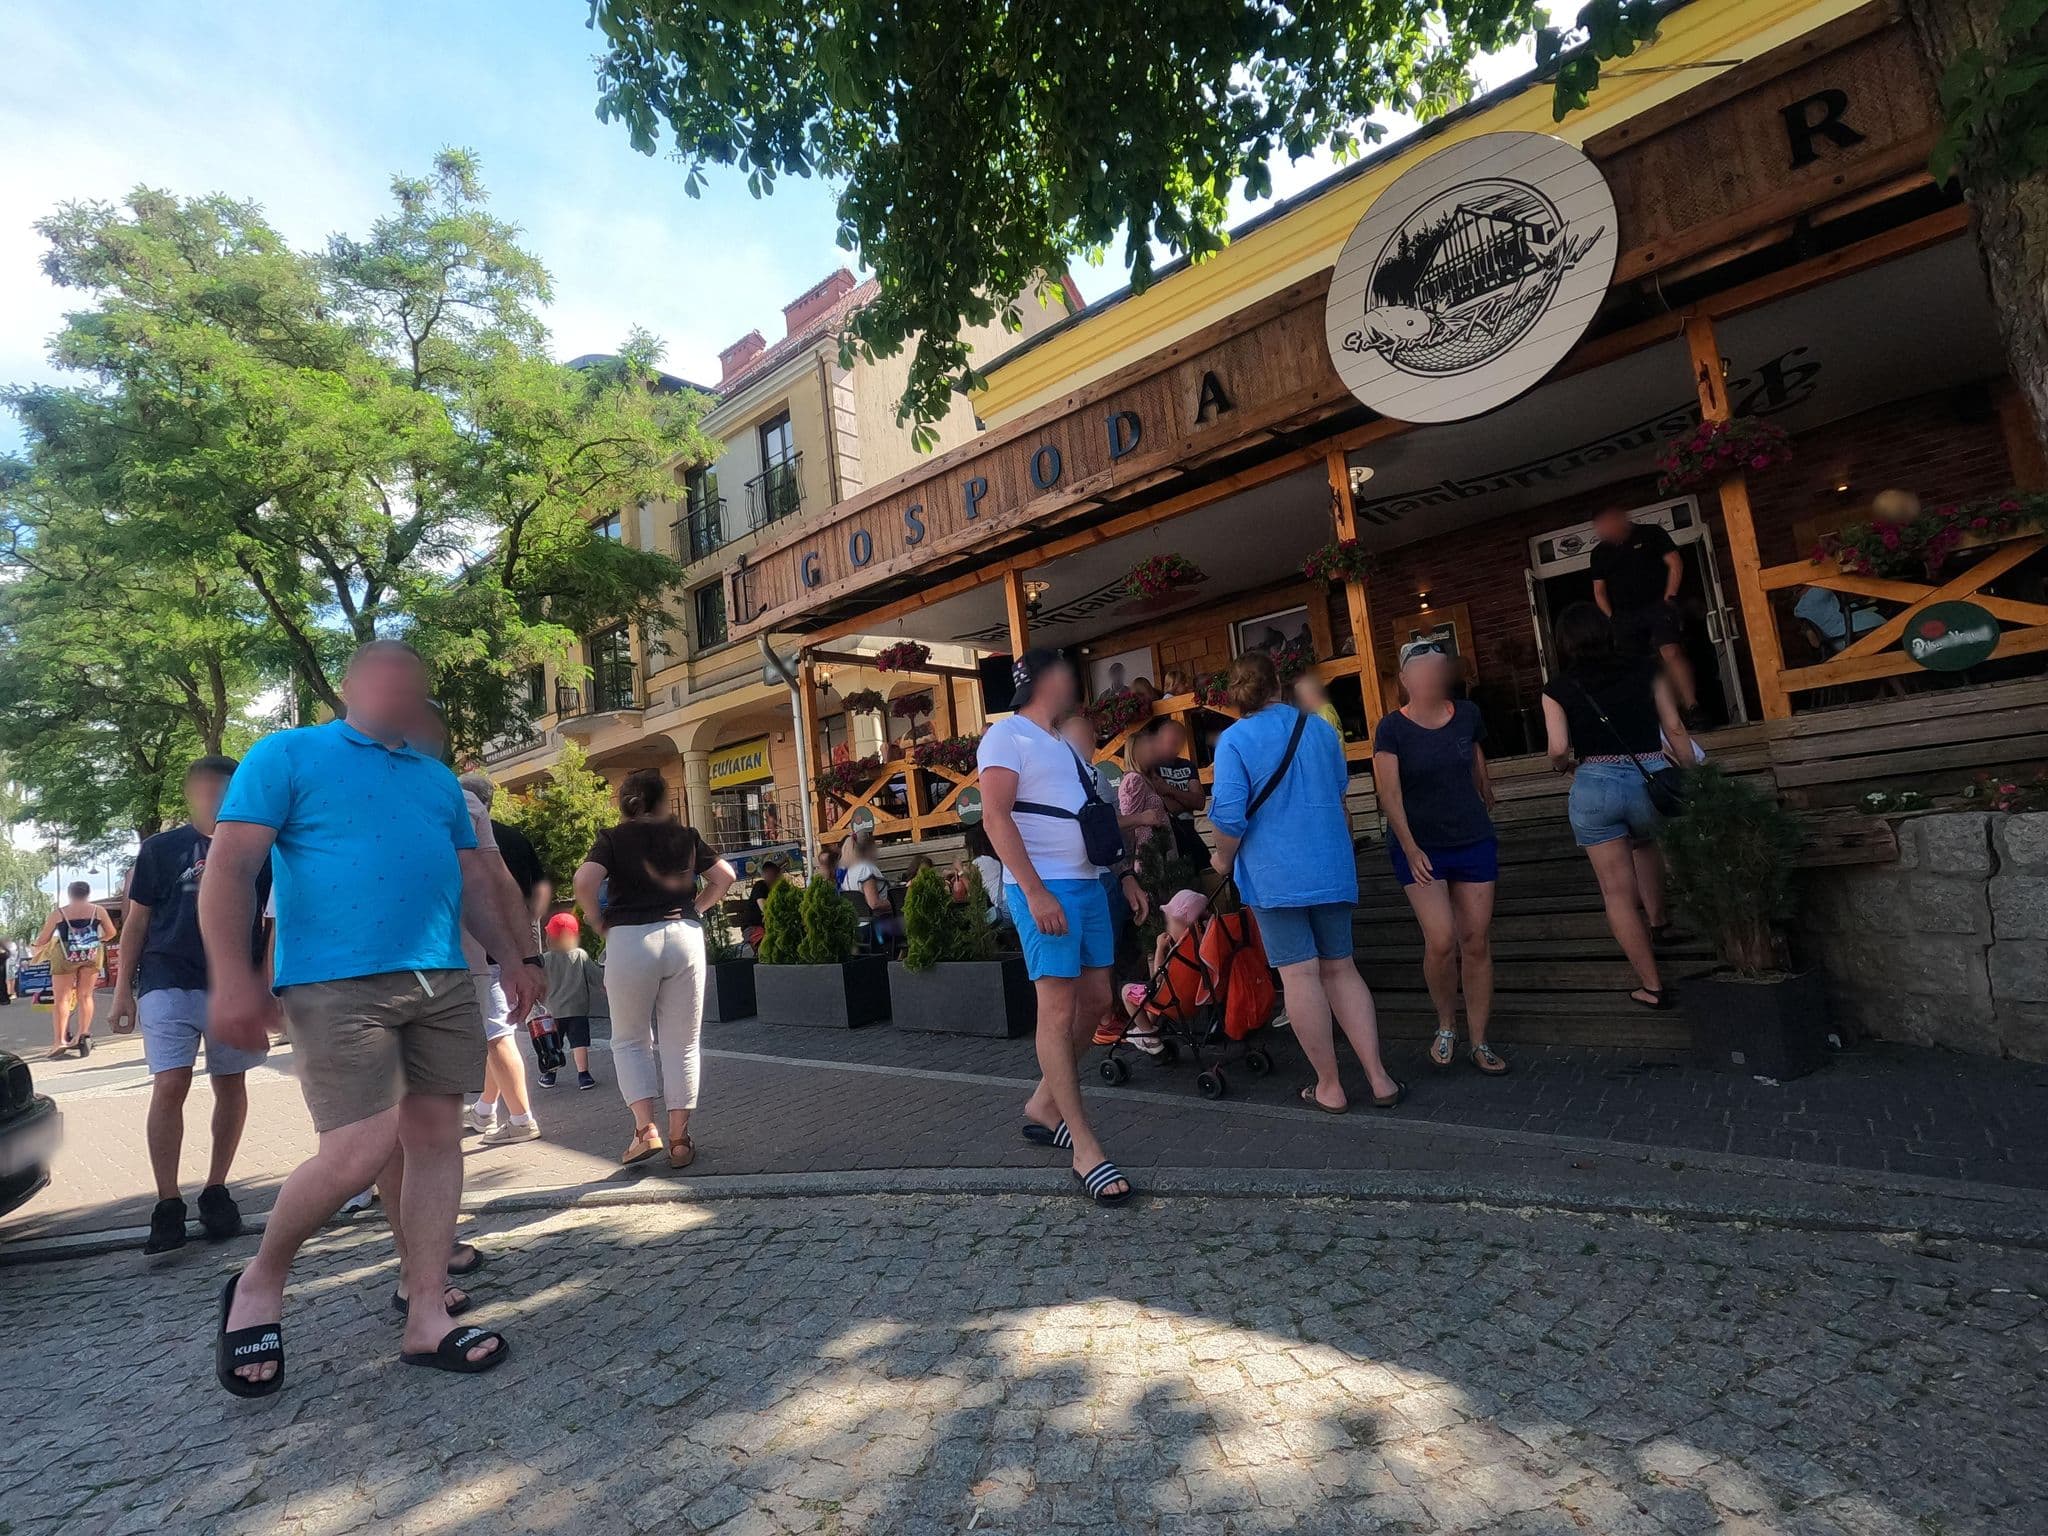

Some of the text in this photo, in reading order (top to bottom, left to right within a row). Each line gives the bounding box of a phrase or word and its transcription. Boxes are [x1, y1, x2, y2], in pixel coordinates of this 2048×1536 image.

[1342, 321, 1466, 363] Gospoda
[800, 369, 1233, 588] GOSPODA
[235, 1340, 280, 1356] KUBOTA
